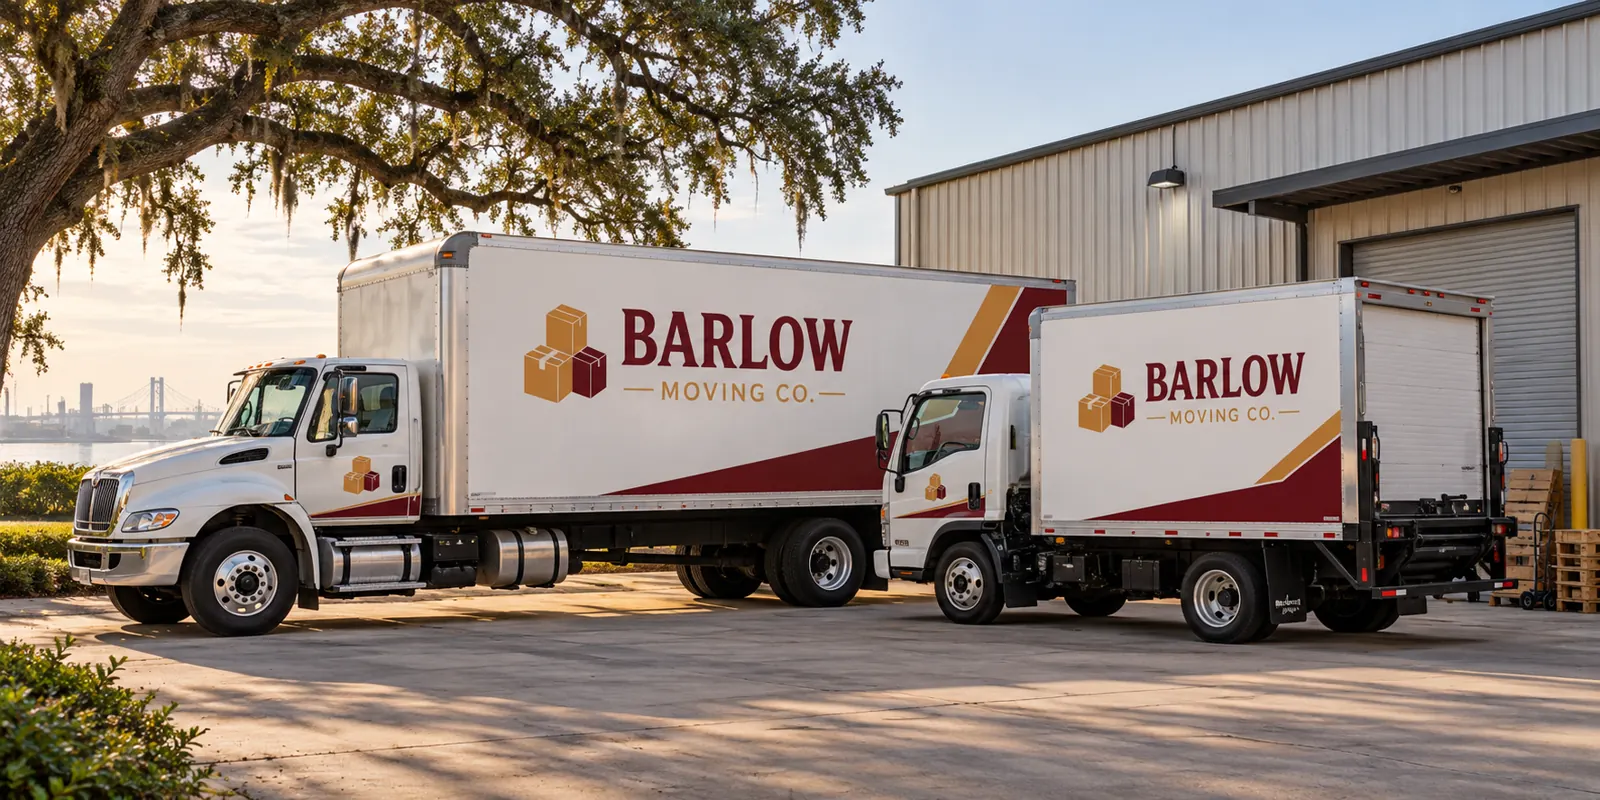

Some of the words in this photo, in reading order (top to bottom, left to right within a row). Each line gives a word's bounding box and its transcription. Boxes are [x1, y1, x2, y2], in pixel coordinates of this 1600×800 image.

[622, 308, 853, 372] BARLOW
[661, 381, 765, 402] MOVING
[775, 383, 815, 403] CO.
[1145, 351, 1306, 403] BARLOW
[1169, 408, 1239, 425] MOVING
[1247, 406, 1275, 422] CO.
